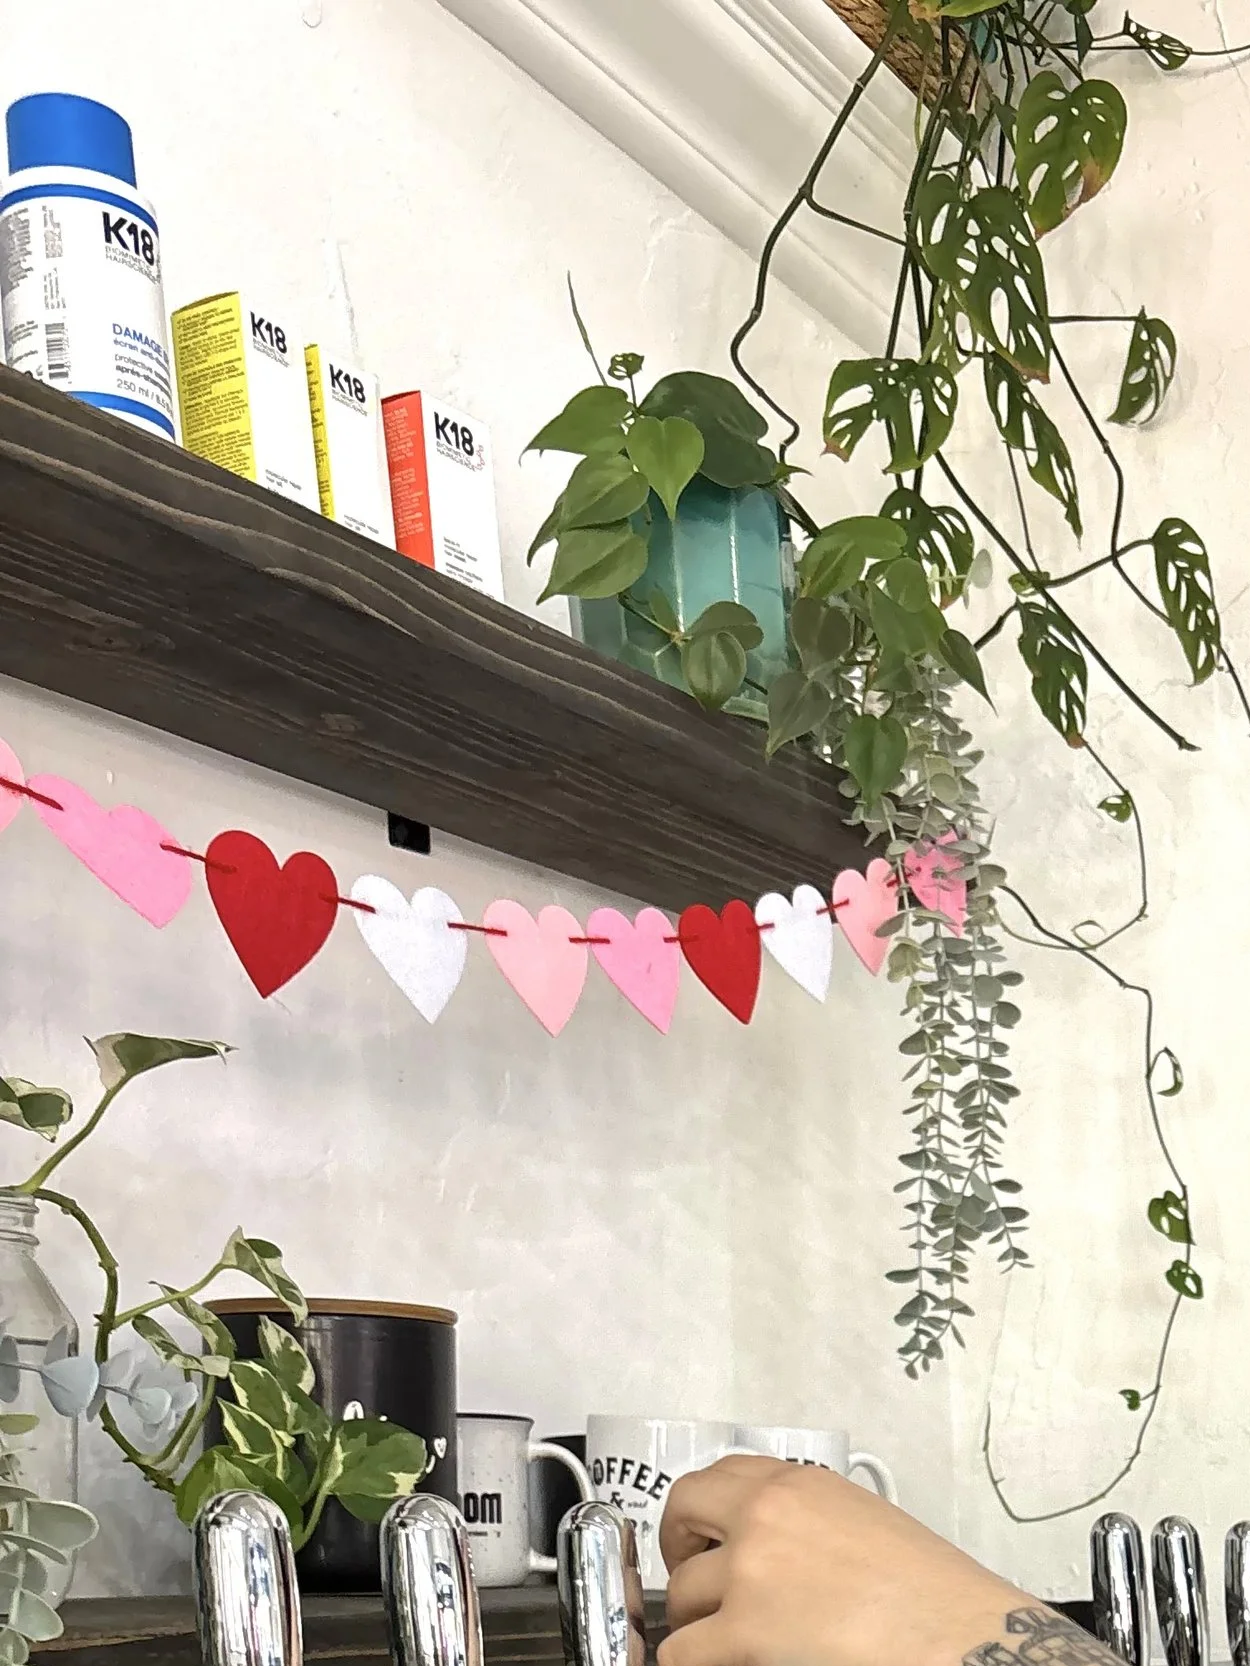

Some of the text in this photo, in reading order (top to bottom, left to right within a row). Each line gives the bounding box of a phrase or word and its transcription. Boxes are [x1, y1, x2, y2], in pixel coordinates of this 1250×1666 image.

[102, 211, 154, 266] K18
[112, 323, 162, 357] DAMAGE
[250, 311, 287, 354] K18
[116, 378, 136, 392] 250
[329, 364, 365, 404] K18
[434, 411, 474, 457] K18
[463, 1492, 503, 1524] om
